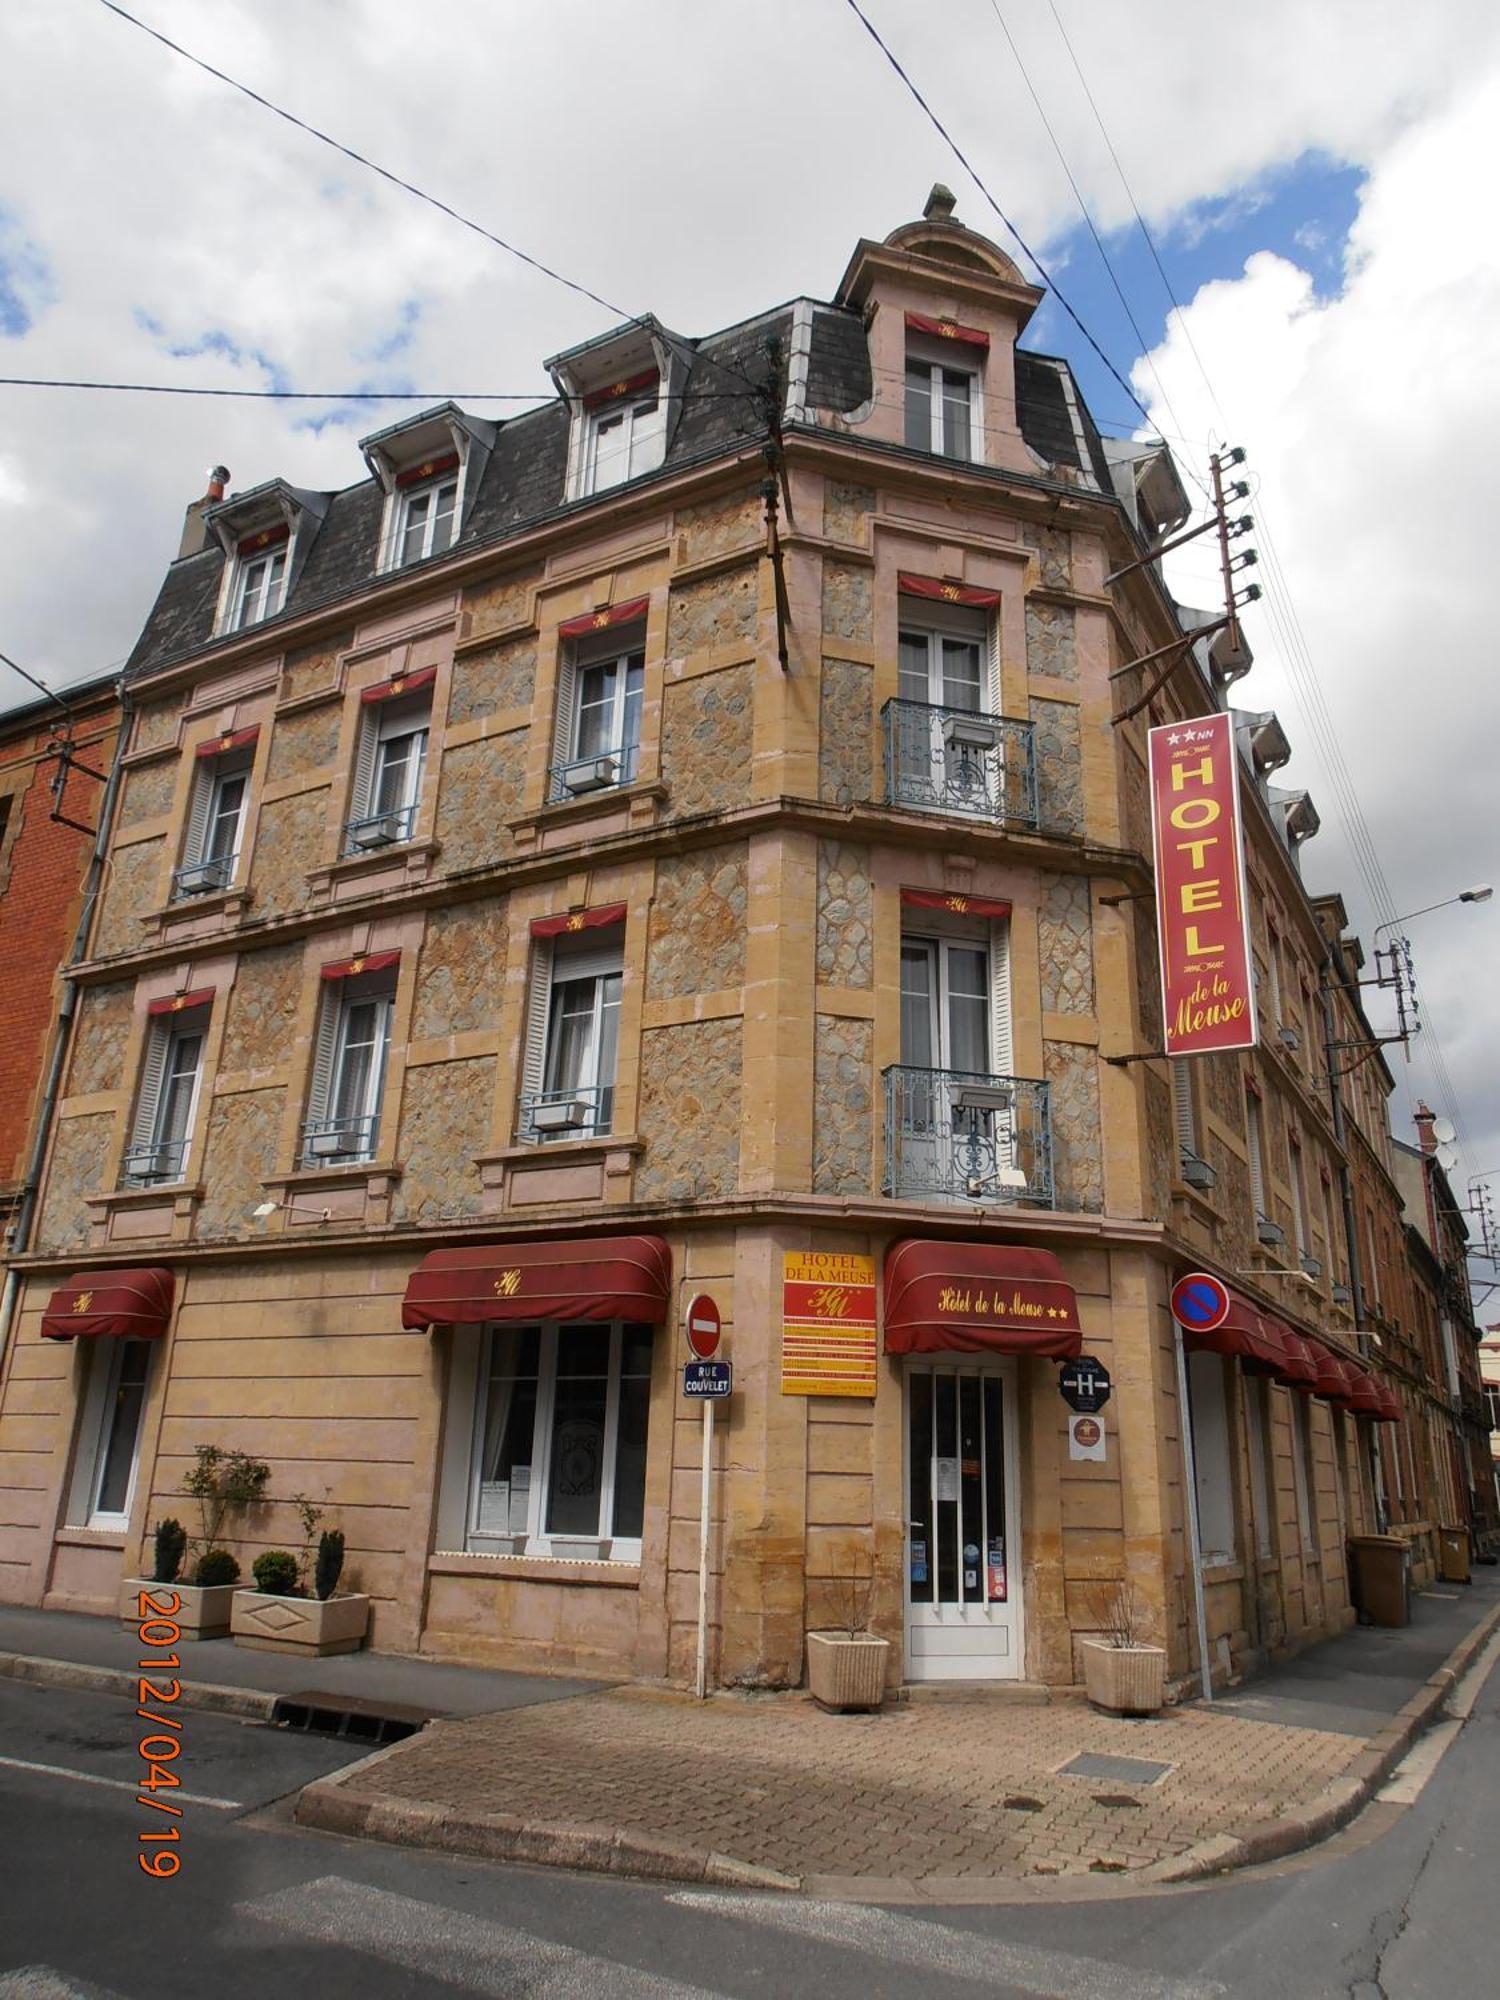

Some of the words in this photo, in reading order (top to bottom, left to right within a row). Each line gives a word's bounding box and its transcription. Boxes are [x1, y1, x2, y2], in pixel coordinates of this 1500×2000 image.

[1196, 728, 1215, 742] NN
[1170, 756, 1225, 956] HOTEL
[1190, 979, 1211, 1005] de
[1212, 973, 1231, 996] la
[1167, 996, 1247, 1039] Meuse
[786, 1267, 805, 1281] DE
[808, 1269, 826, 1282] LA
[830, 1271, 875, 1285] MEUSE
[975, 1290, 989, 1313] de
[993, 1291, 1007, 1315] la
[1008, 1291, 1044, 1317] Meuse
[698, 1366, 717, 1377] RUE
[686, 1380, 728, 1392] COUVELET
[1077, 1373, 1094, 1395] H
